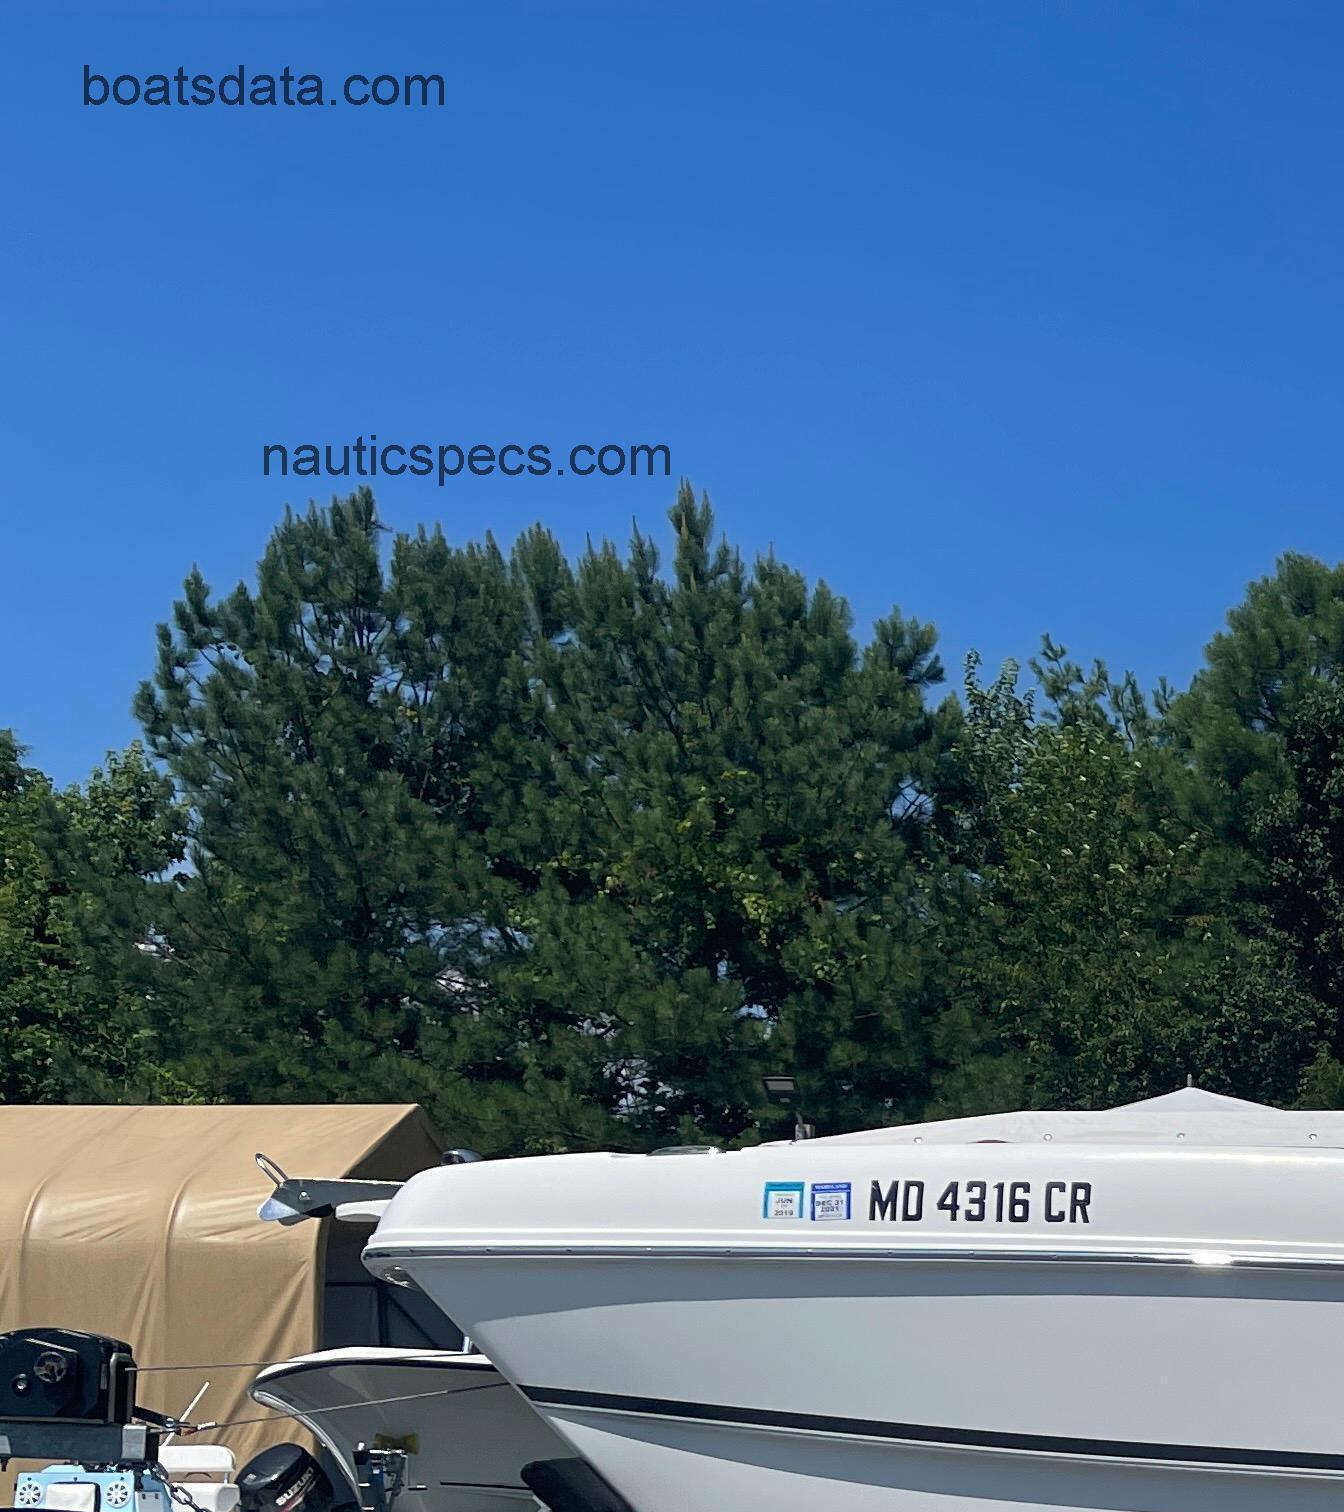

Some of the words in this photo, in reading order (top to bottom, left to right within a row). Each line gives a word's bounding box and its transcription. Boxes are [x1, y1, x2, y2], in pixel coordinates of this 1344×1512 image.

[869, 1180, 925, 1221] MD
[936, 1181, 1031, 1222] 4316
[1044, 1182, 1092, 1223] CR
